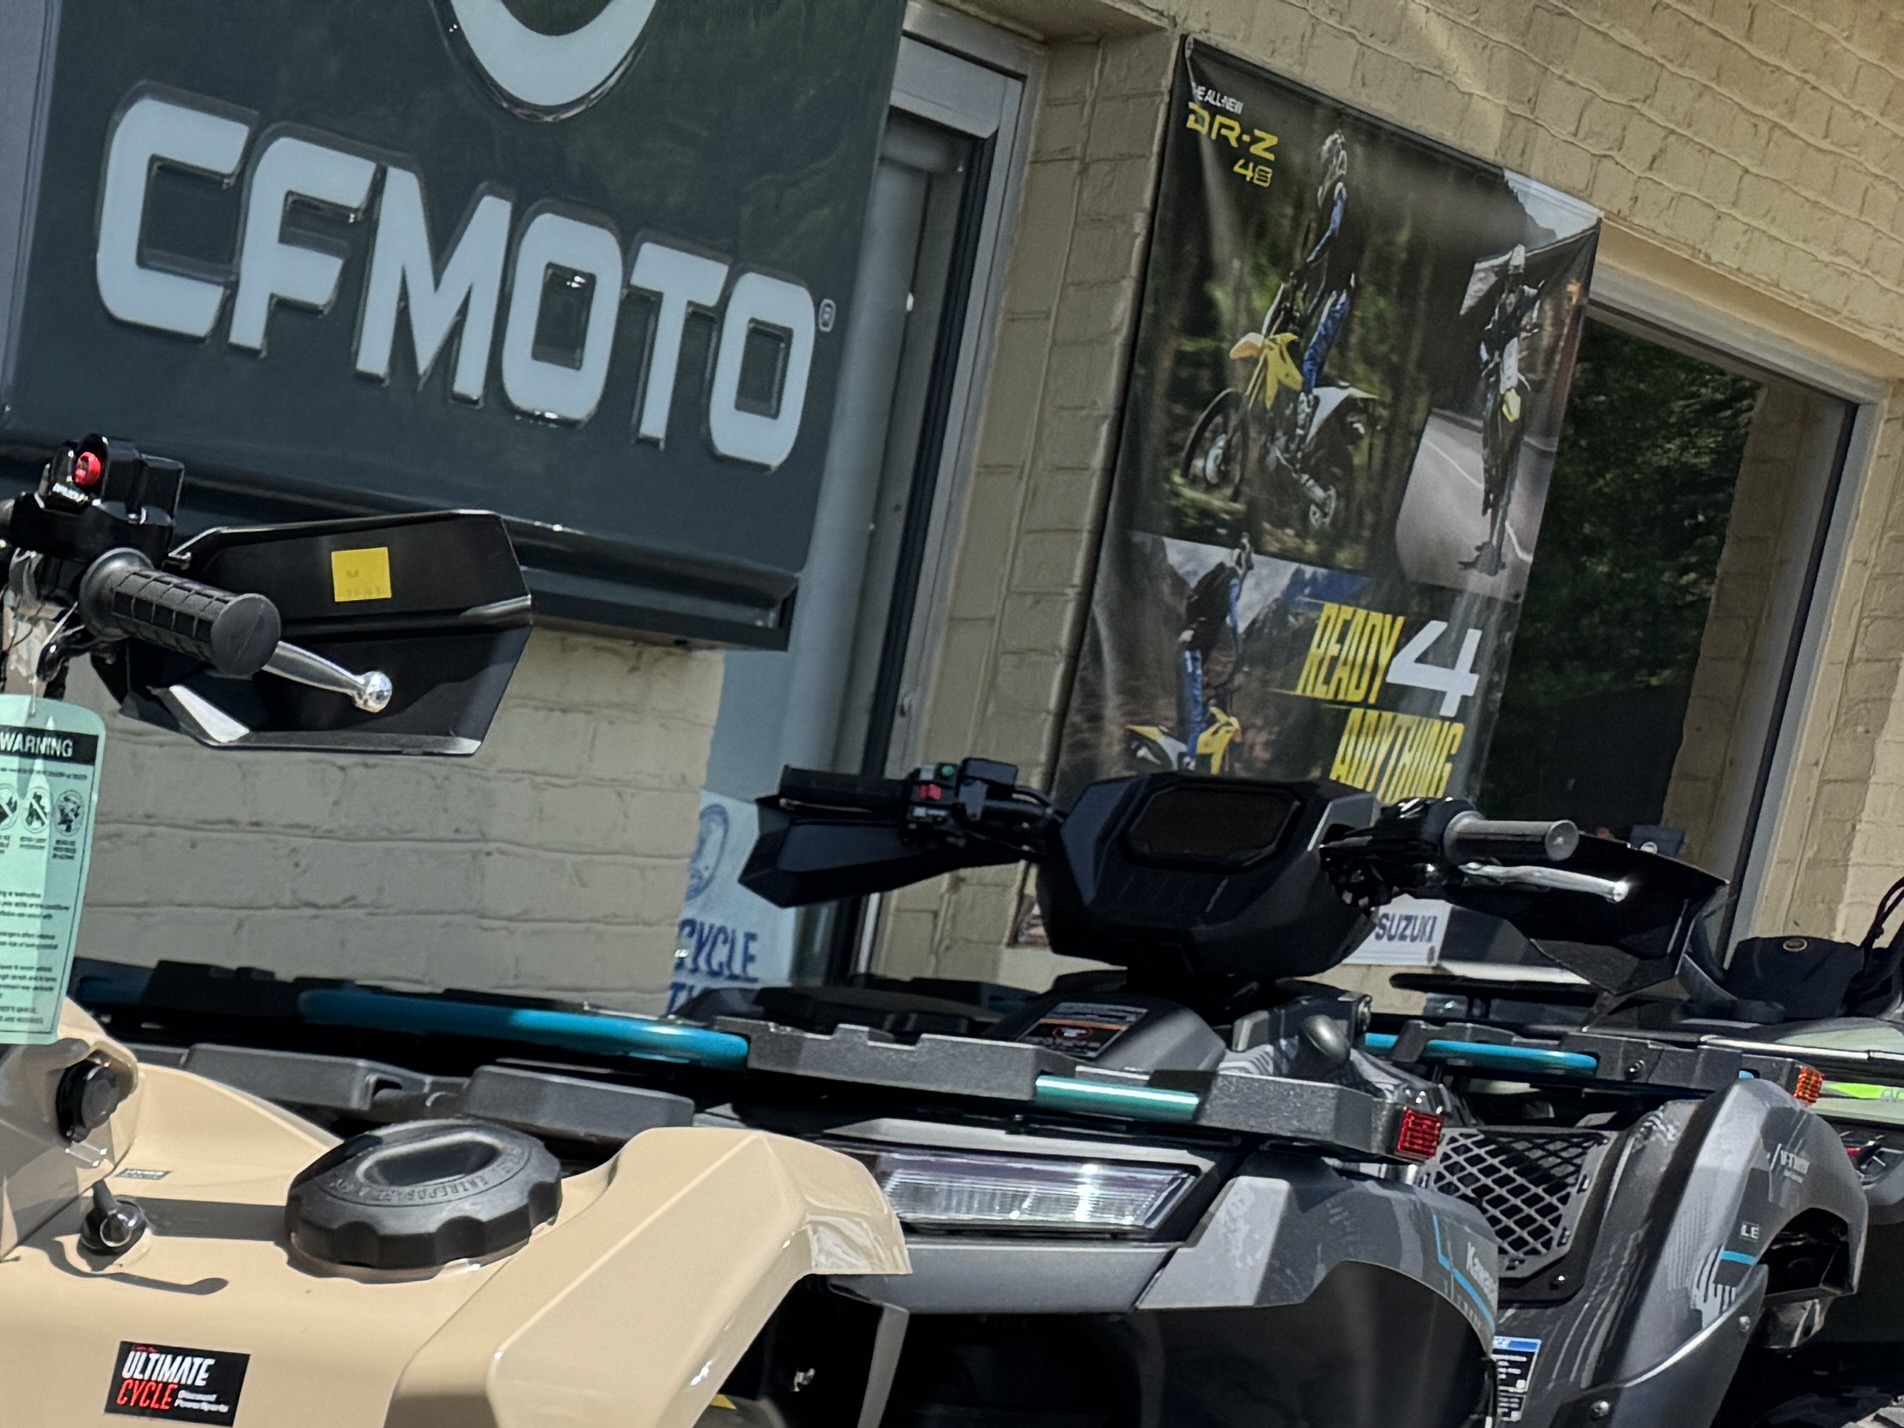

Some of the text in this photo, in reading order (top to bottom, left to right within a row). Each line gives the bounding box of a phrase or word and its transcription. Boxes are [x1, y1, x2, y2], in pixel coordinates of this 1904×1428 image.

[1186, 101, 1278, 161] DR-Z
[95, 94, 816, 470] CFMOTO
[1296, 602, 1483, 718] READY 4
[0, 730, 73, 758] WARNING
[1329, 708, 1465, 806] ANYTHING
[1375, 912, 1437, 943] SUZUKI
[122, 1350, 215, 1387] ULTIMATE
[116, 1378, 179, 1411] CYCLE
